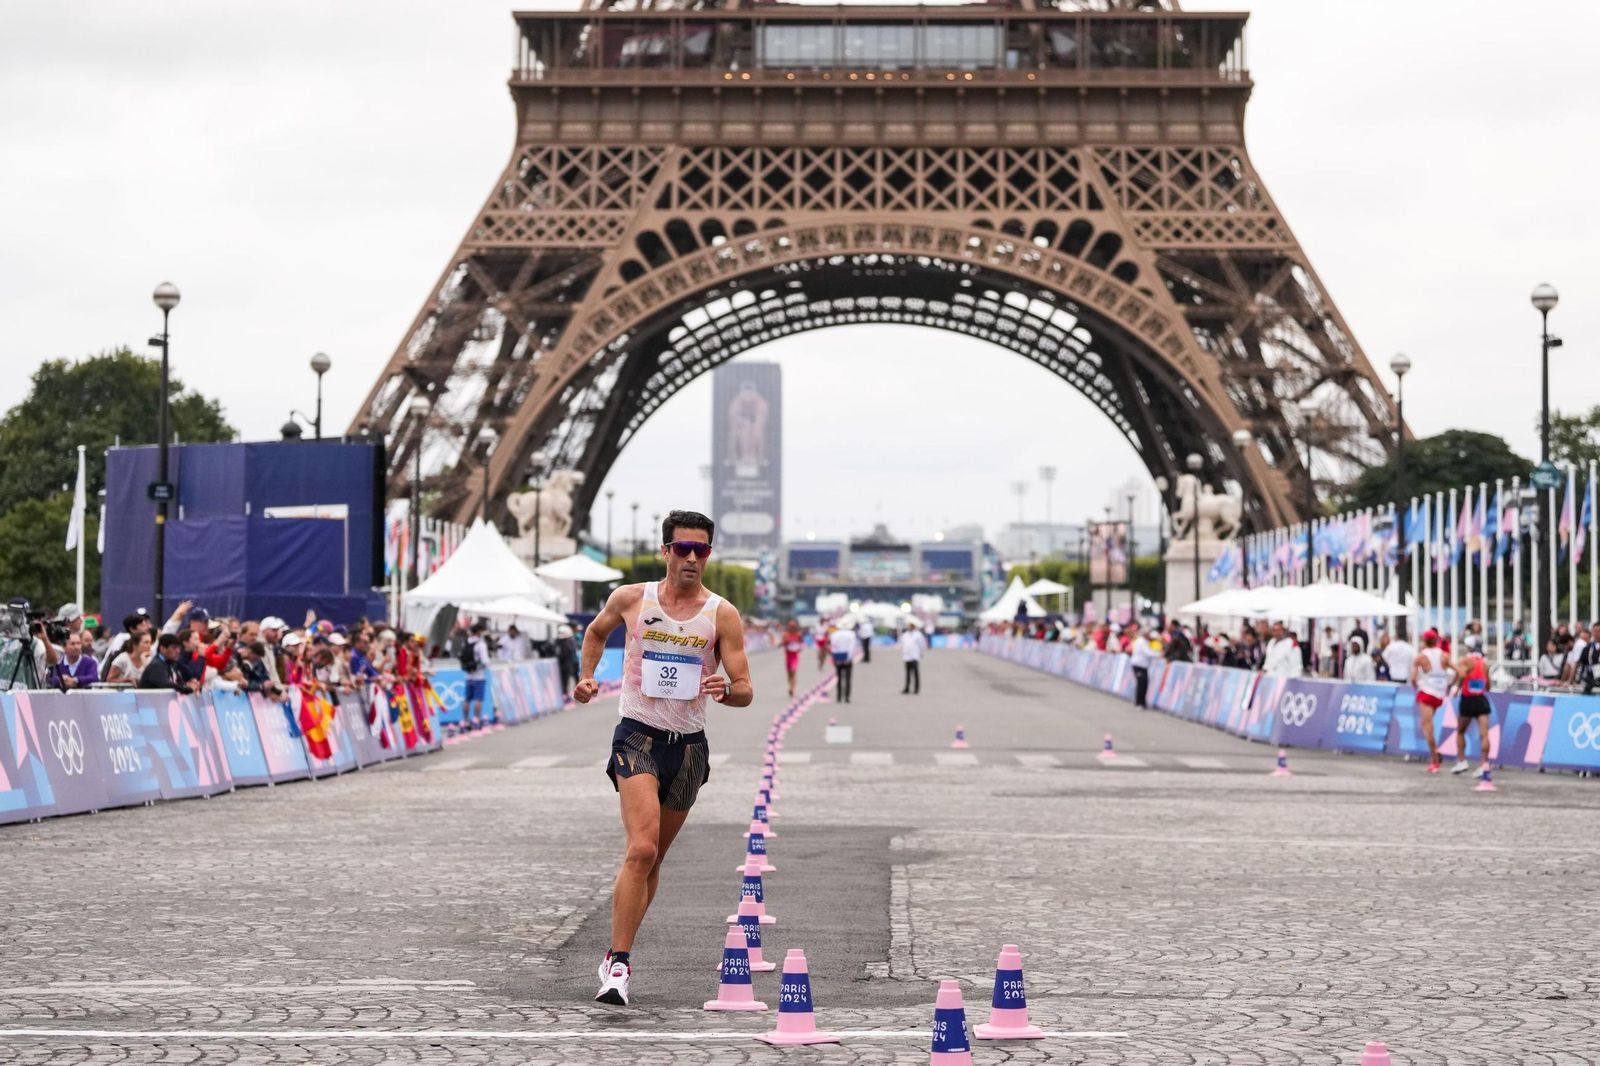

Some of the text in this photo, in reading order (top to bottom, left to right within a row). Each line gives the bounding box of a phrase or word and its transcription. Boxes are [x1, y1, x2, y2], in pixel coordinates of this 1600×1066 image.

[643, 629, 708, 648] ESPAÑA
[660, 666, 677, 680] 32
[658, 680, 677, 688] LOPEZ
[109, 745, 142, 774] 2024
[743, 924, 760, 932] ARIS
[724, 967, 749, 975] 2024
[780, 994, 807, 1003] 2024
